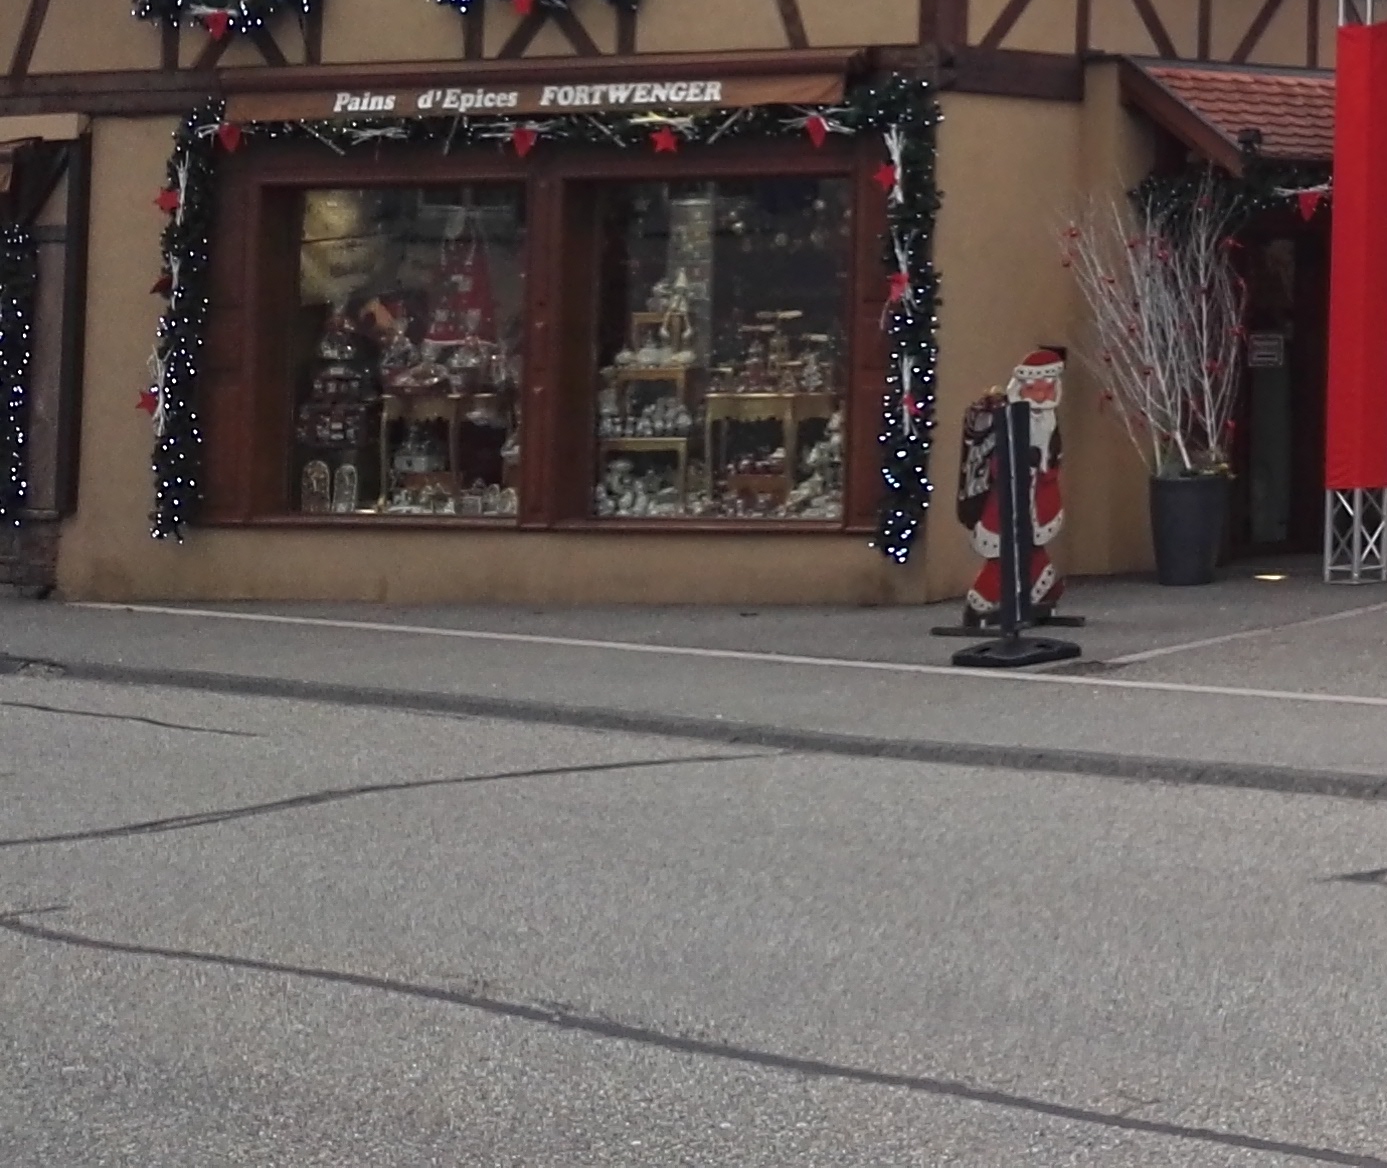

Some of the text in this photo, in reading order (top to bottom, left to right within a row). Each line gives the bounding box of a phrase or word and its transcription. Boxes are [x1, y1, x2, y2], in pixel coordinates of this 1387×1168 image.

[333, 82, 722, 113] Pains d'Epices FORTWENGER
